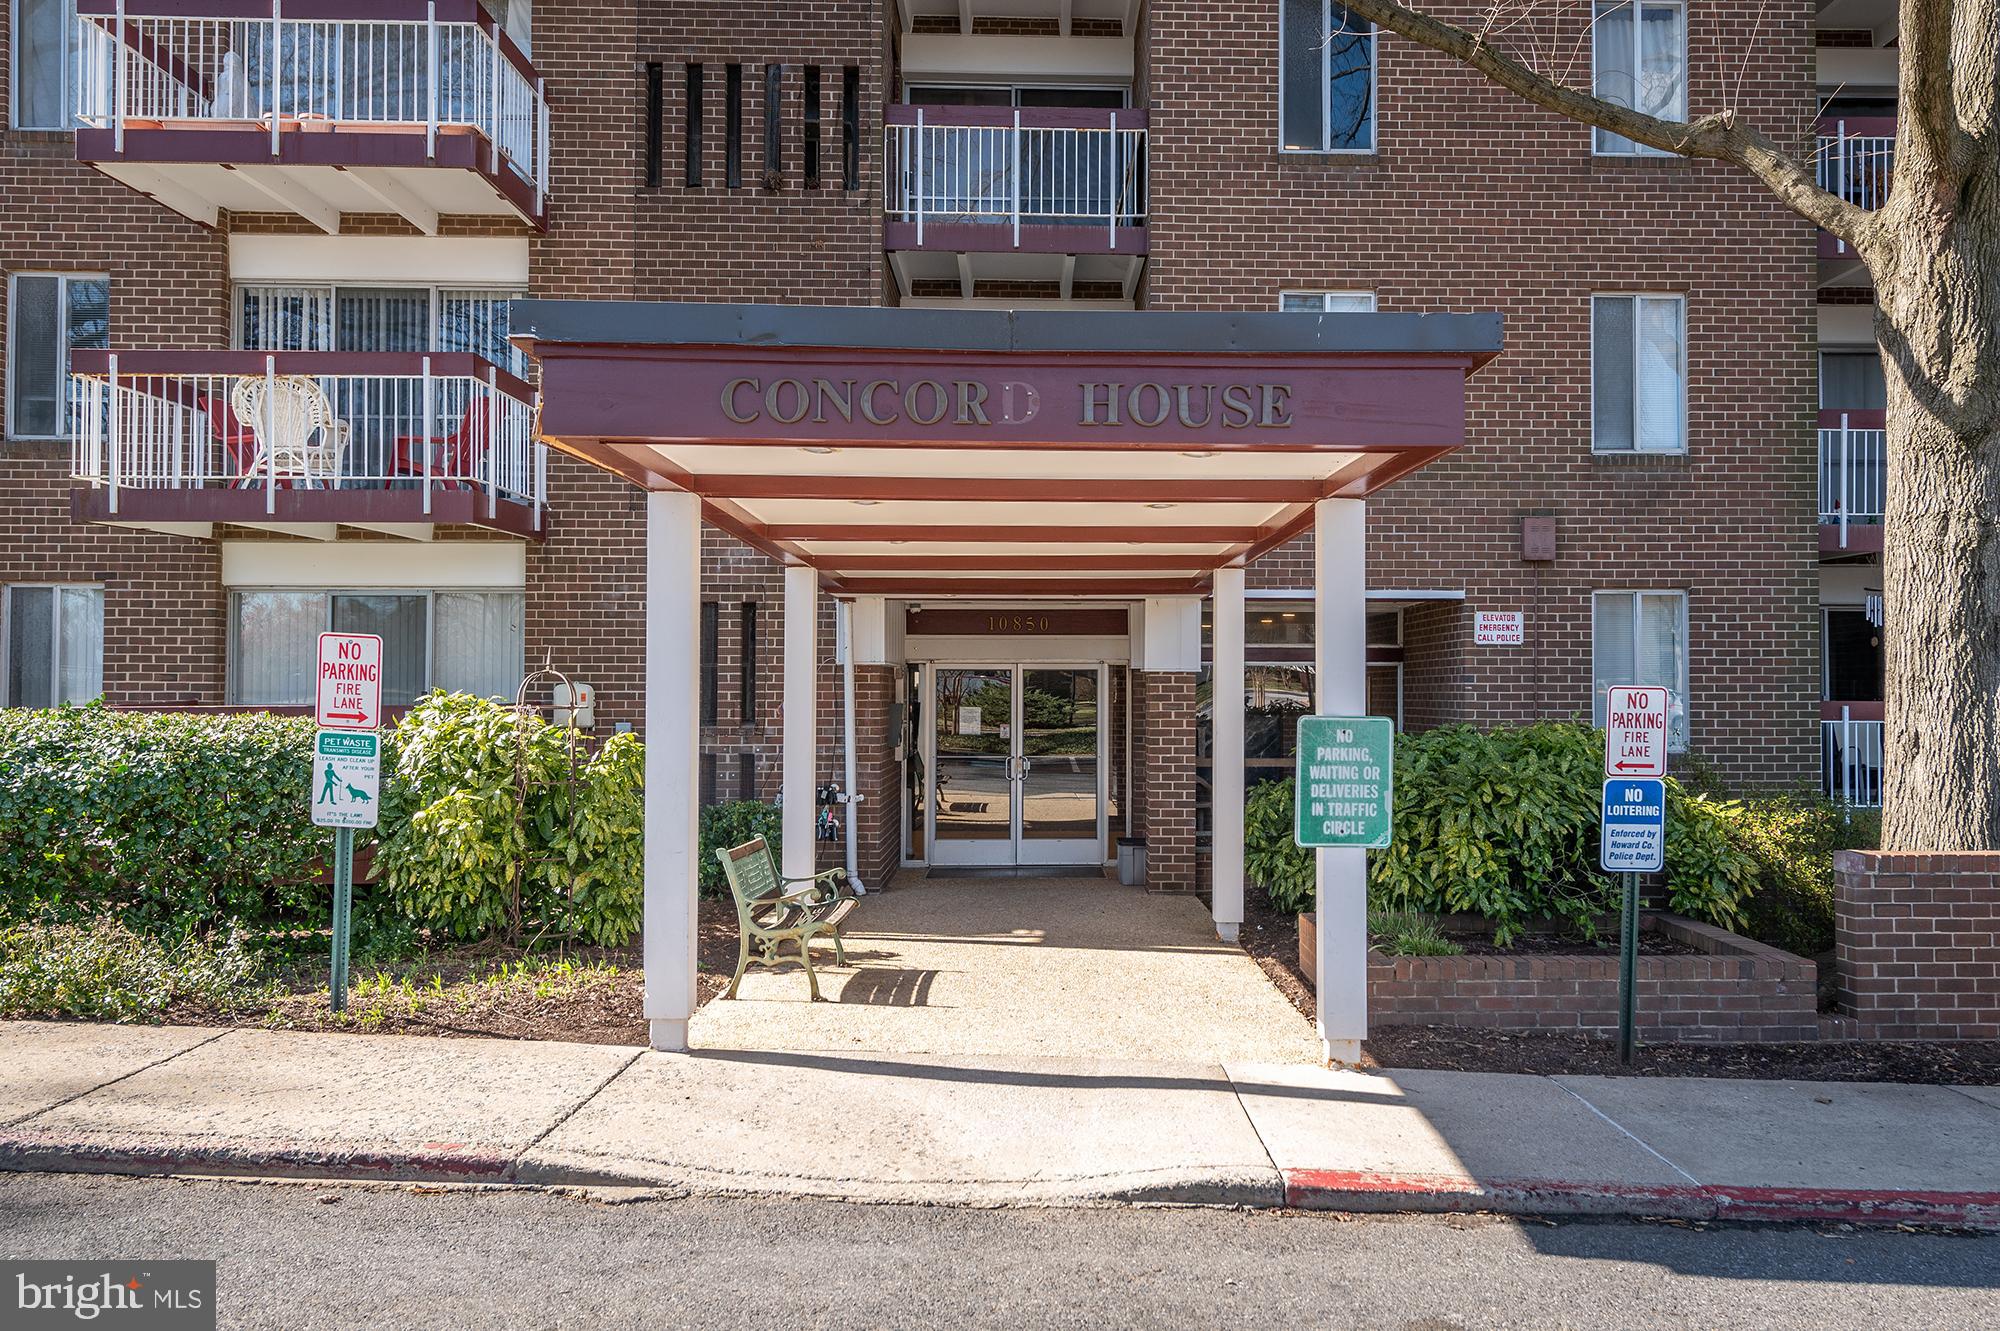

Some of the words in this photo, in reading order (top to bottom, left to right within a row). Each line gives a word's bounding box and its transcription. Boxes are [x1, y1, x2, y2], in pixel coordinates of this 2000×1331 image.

[720, 377, 1040, 425] CONCORD
[1077, 382, 1294, 428] HOUSE
[989, 616, 1049, 631] 10850
[1482, 614, 1516, 622] ELEVATOR
[1479, 624, 1520, 632] EMERGENCY
[1477, 634, 1494, 642] CALL
[1496, 634, 1521, 642] POLICE
[338, 642, 362, 660] NO
[322, 662, 376, 682] PARKING
[336, 683, 362, 696] FIRE
[333, 696, 363, 710] LANE
[1627, 692, 1648, 709] NO
[1612, 712, 1663, 729] PARKING
[324, 737, 342, 746] PET
[342, 738, 371, 747] WASTE
[1336, 729, 1353, 743] NO
[1624, 731, 1649, 743] FIRE
[1317, 747, 1373, 765] PARKING,
[1621, 745, 1650, 757] LANE
[1309, 766, 1359, 780] WAITING
[1363, 766, 1380, 780] OR
[1310, 784, 1379, 798] DELIVERIES
[1624, 788, 1643, 802] NO
[1311, 802, 1324, 816] IN
[1328, 802, 1378, 816] TRAFFIC
[1607, 804, 1660, 816] LOITERING
[1322, 821, 1365, 836] CIRCLE
[1610, 829, 1646, 838] Enforced
[1647, 830, 1657, 840] by
[1610, 841, 1641, 849] Howard
[1641, 841, 1655, 850] Co.
[1608, 852, 1634, 860] Police
[1635, 852, 1656, 862] Dept.
